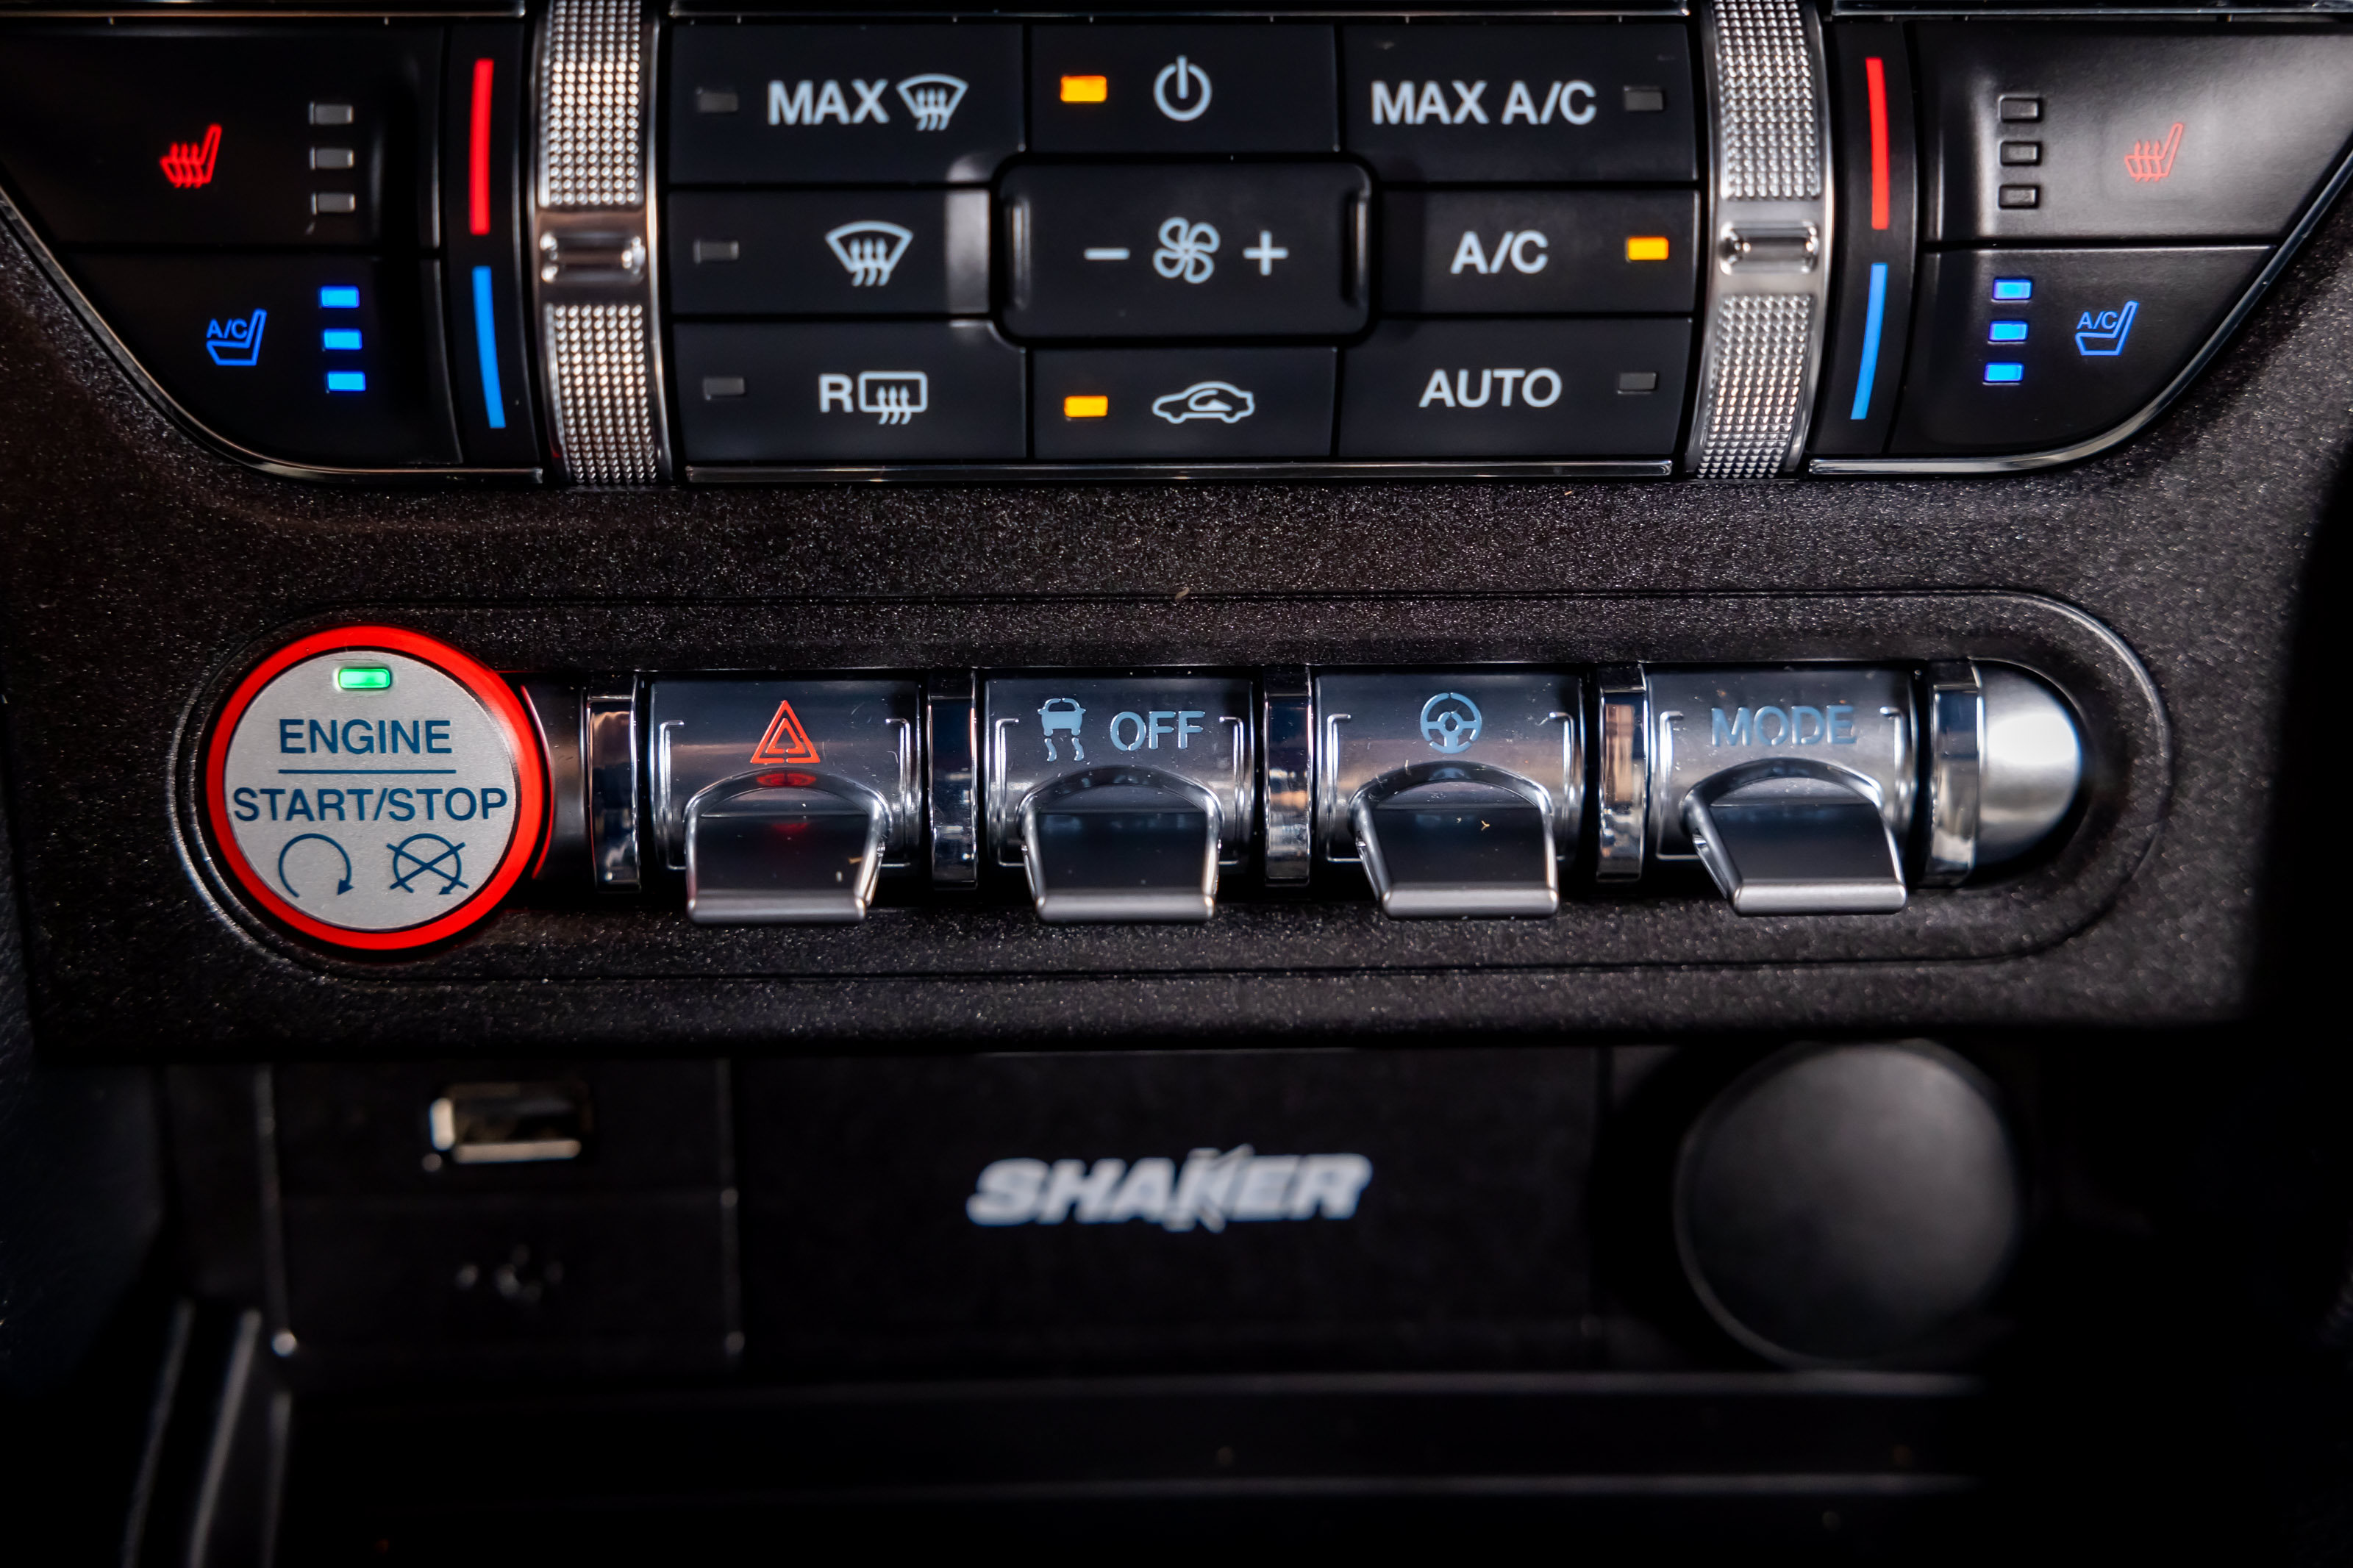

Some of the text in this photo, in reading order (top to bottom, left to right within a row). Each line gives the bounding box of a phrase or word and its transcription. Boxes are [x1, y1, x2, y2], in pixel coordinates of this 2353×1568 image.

[767, 80, 890, 126] MAX
[1371, 80, 1598, 126] MAX A/C
[1450, 231, 1549, 275] A/C
[207, 319, 248, 340] A/C
[2076, 311, 2118, 330] A/C
[819, 373, 853, 413] R
[1419, 368, 1563, 409] AUTO
[279, 719, 453, 755] ENGINE
[1109, 710, 1207, 751] OFF
[1710, 704, 1857, 748] MODE
[233, 787, 509, 822] START/STOP
[966, 1144, 1374, 1233] SHAKER
